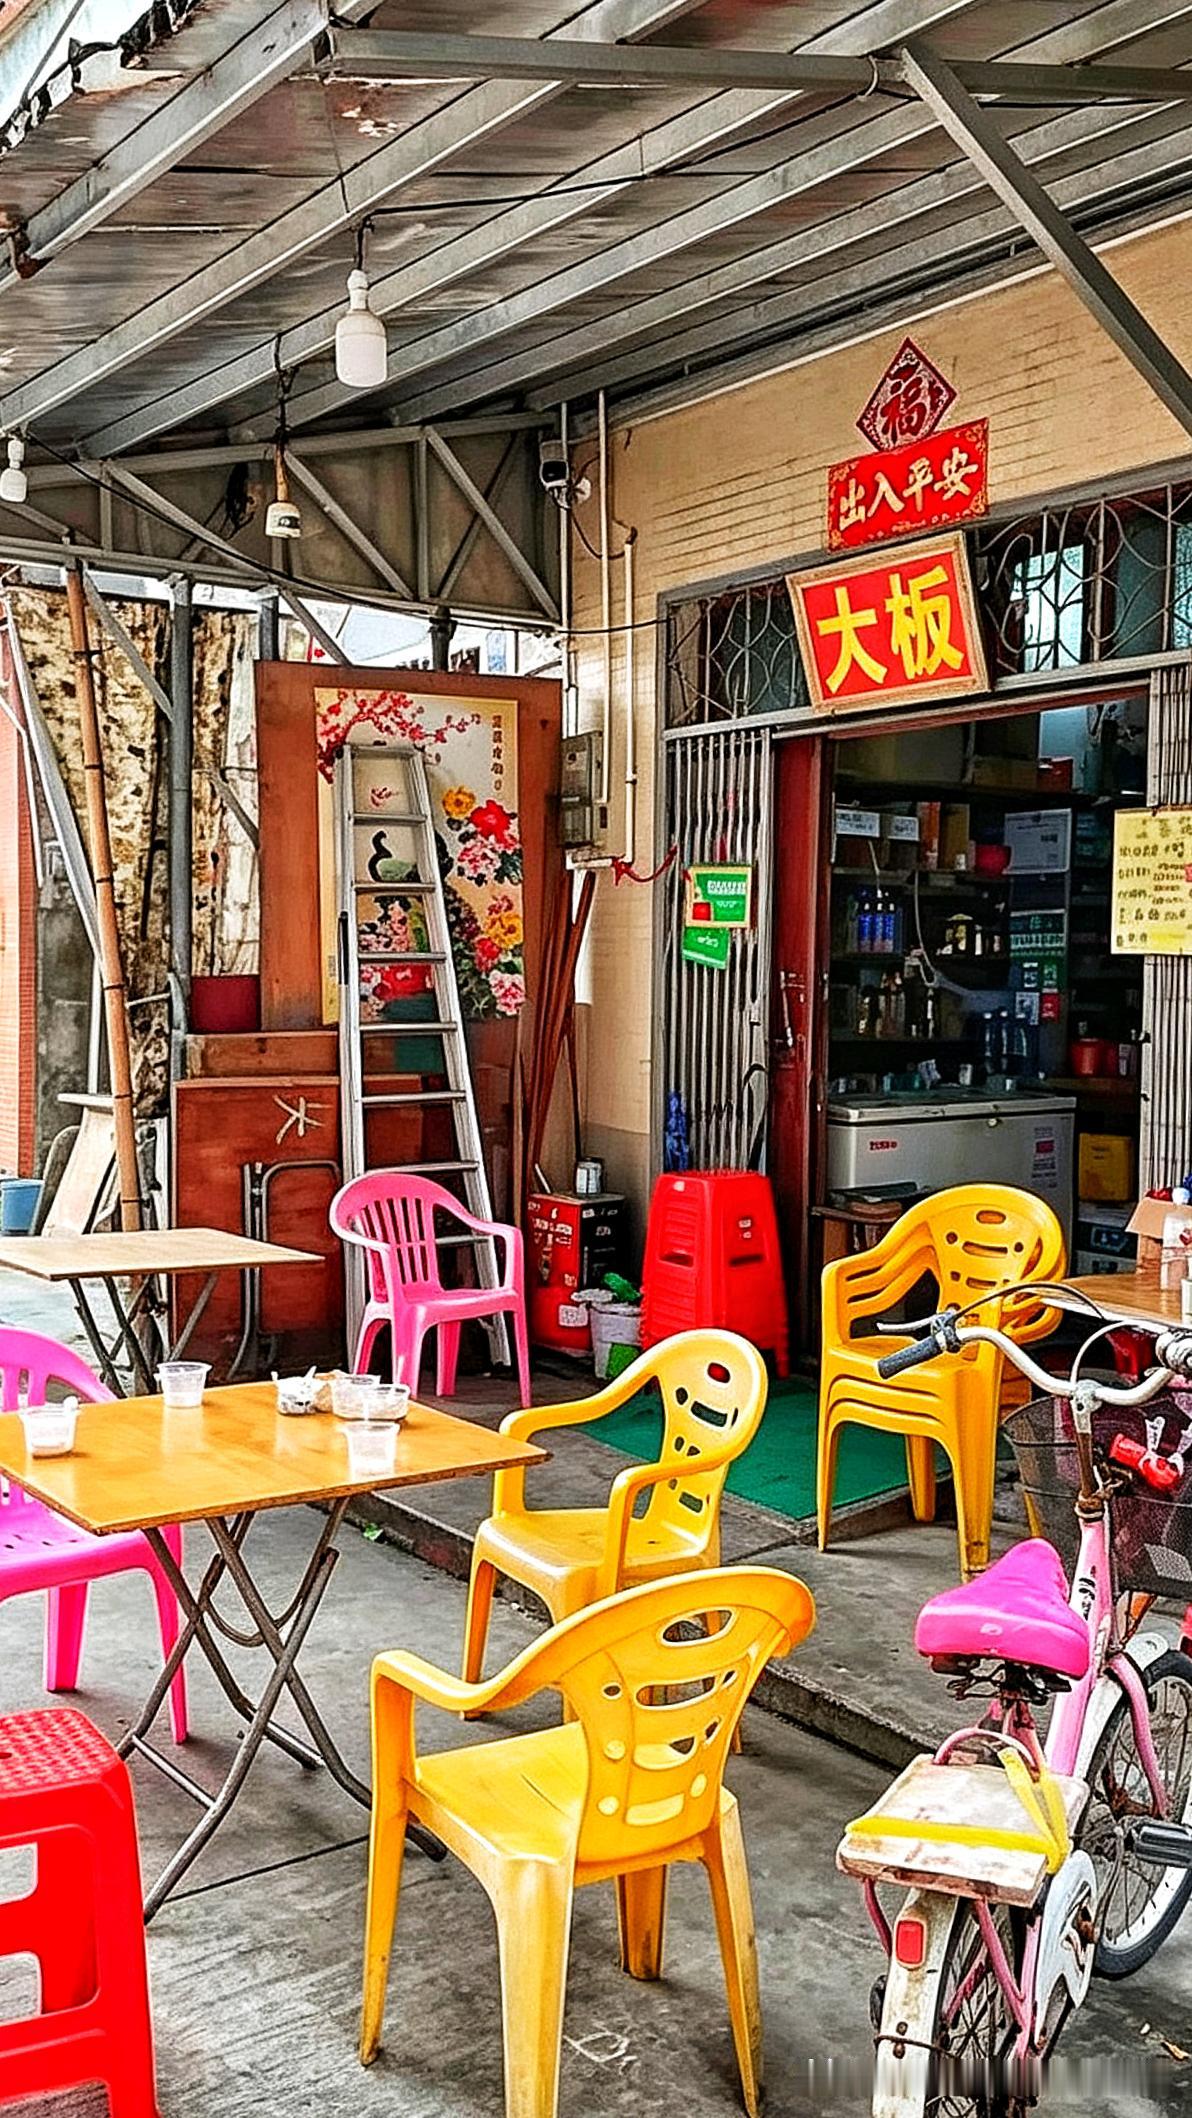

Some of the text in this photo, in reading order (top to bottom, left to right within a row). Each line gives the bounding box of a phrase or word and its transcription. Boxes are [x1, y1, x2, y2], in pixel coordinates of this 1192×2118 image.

[878, 368, 928, 444] 福
[838, 446, 978, 531] 出入平安
[816, 567, 965, 694] 大板
